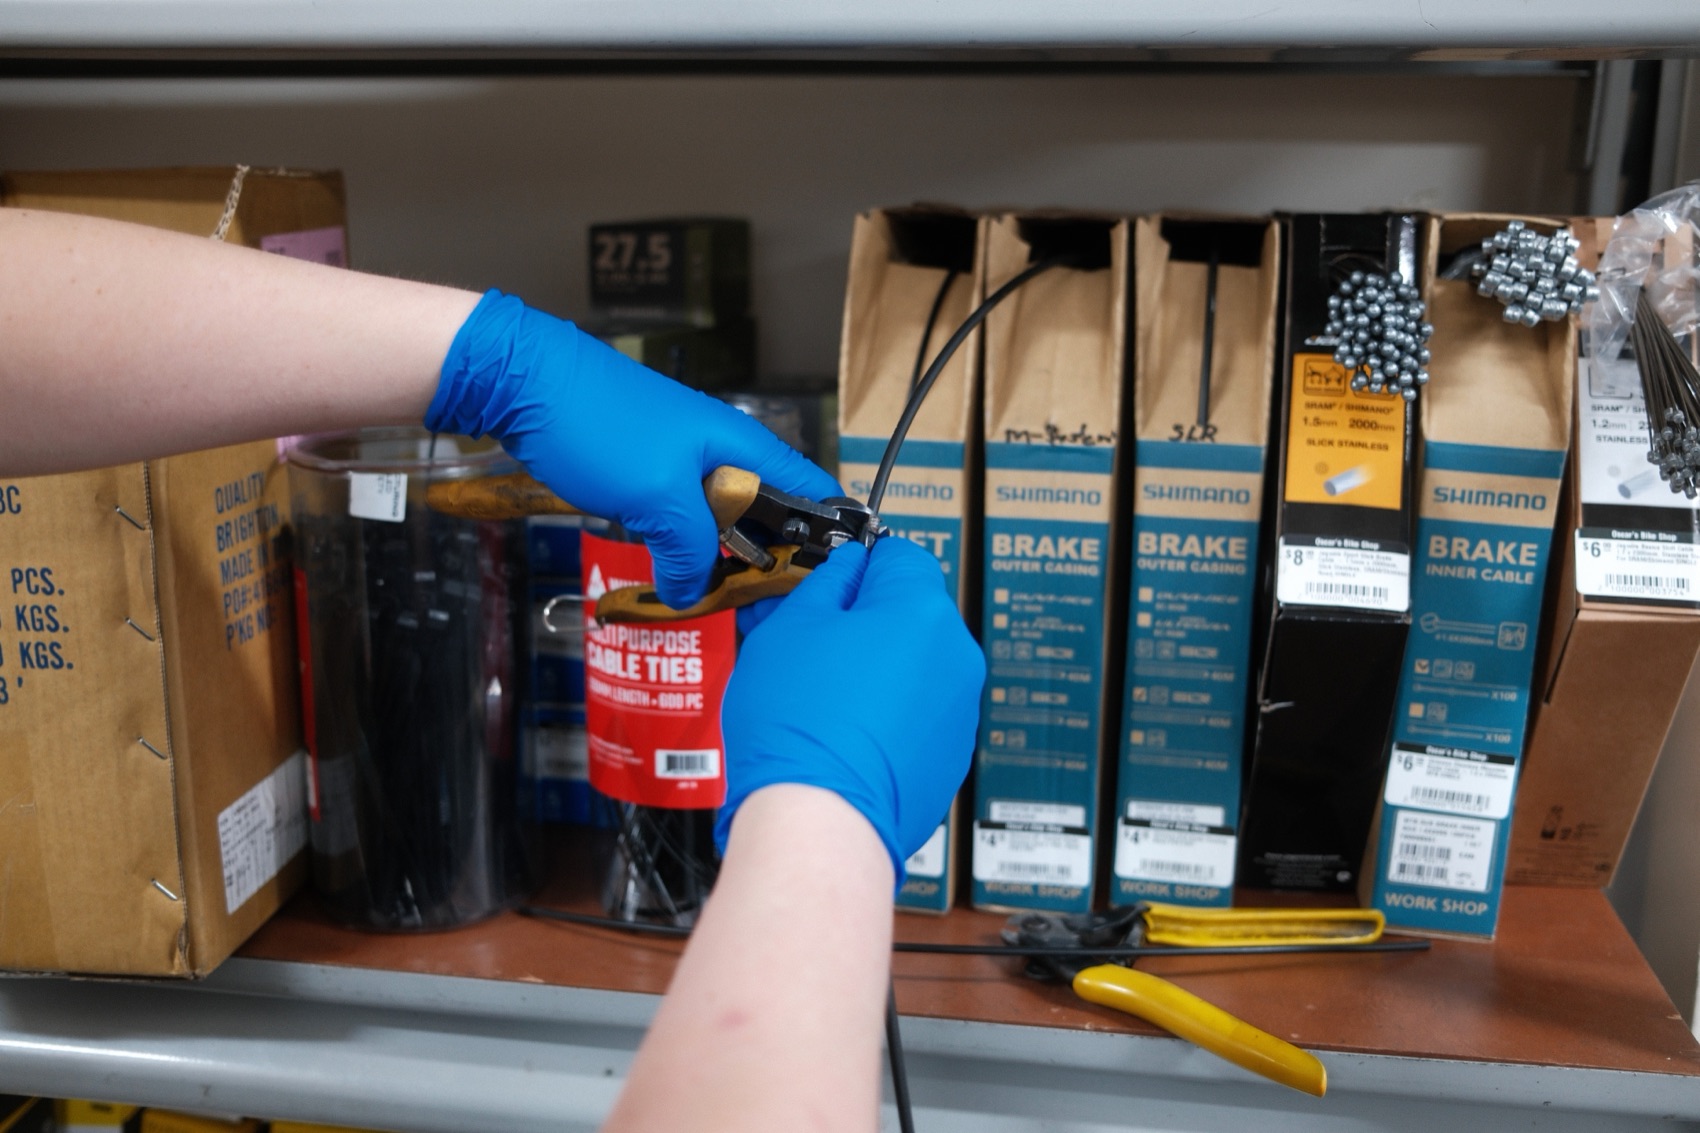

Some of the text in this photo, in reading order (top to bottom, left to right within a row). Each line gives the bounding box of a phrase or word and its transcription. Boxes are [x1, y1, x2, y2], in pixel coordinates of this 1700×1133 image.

[595, 231, 671, 270] 27.5
[1168, 423, 1218, 443] SLR
[1348, 418, 1396, 432] 2000mm
[1592, 419, 1627, 430] 1.2mm
[1306, 438, 1389, 452] SLICK STAINLESS
[1596, 435, 1648, 445] STAINLESS
[214, 472, 266, 514] QUALITY
[996, 485, 1102, 506] SHIMANO
[1143, 483, 1251, 505] SHIMANO
[1433, 486, 1547, 511] SHIMANO
[216, 503, 279, 553] BRIGHTON
[1640, 531, 1657, 540] Bike
[1658, 532, 1677, 542] Shop
[992, 533, 1100, 561] BRAKE
[1138, 531, 1248, 560] BRAKE
[1428, 535, 1538, 566] BRAKE
[220, 550, 254, 587] MADE
[992, 560, 1099, 576] OUTER CASING
[1137, 557, 1246, 575] OUTER CASING
[1426, 563, 1535, 584] INNER CABLE
[11, 567, 65, 596] PCS.
[15, 604, 69, 633] KGS.
[19, 641, 73, 669] KGS.
[587, 641, 704, 684] CABLE TIES
[612, 685, 650, 707] LENGTH
[685, 692, 704, 710] PC
[1038, 882, 1083, 898] SHOP
[1120, 880, 1221, 900] WORK SHOP
[1385, 892, 1488, 916] WORK SHOP
